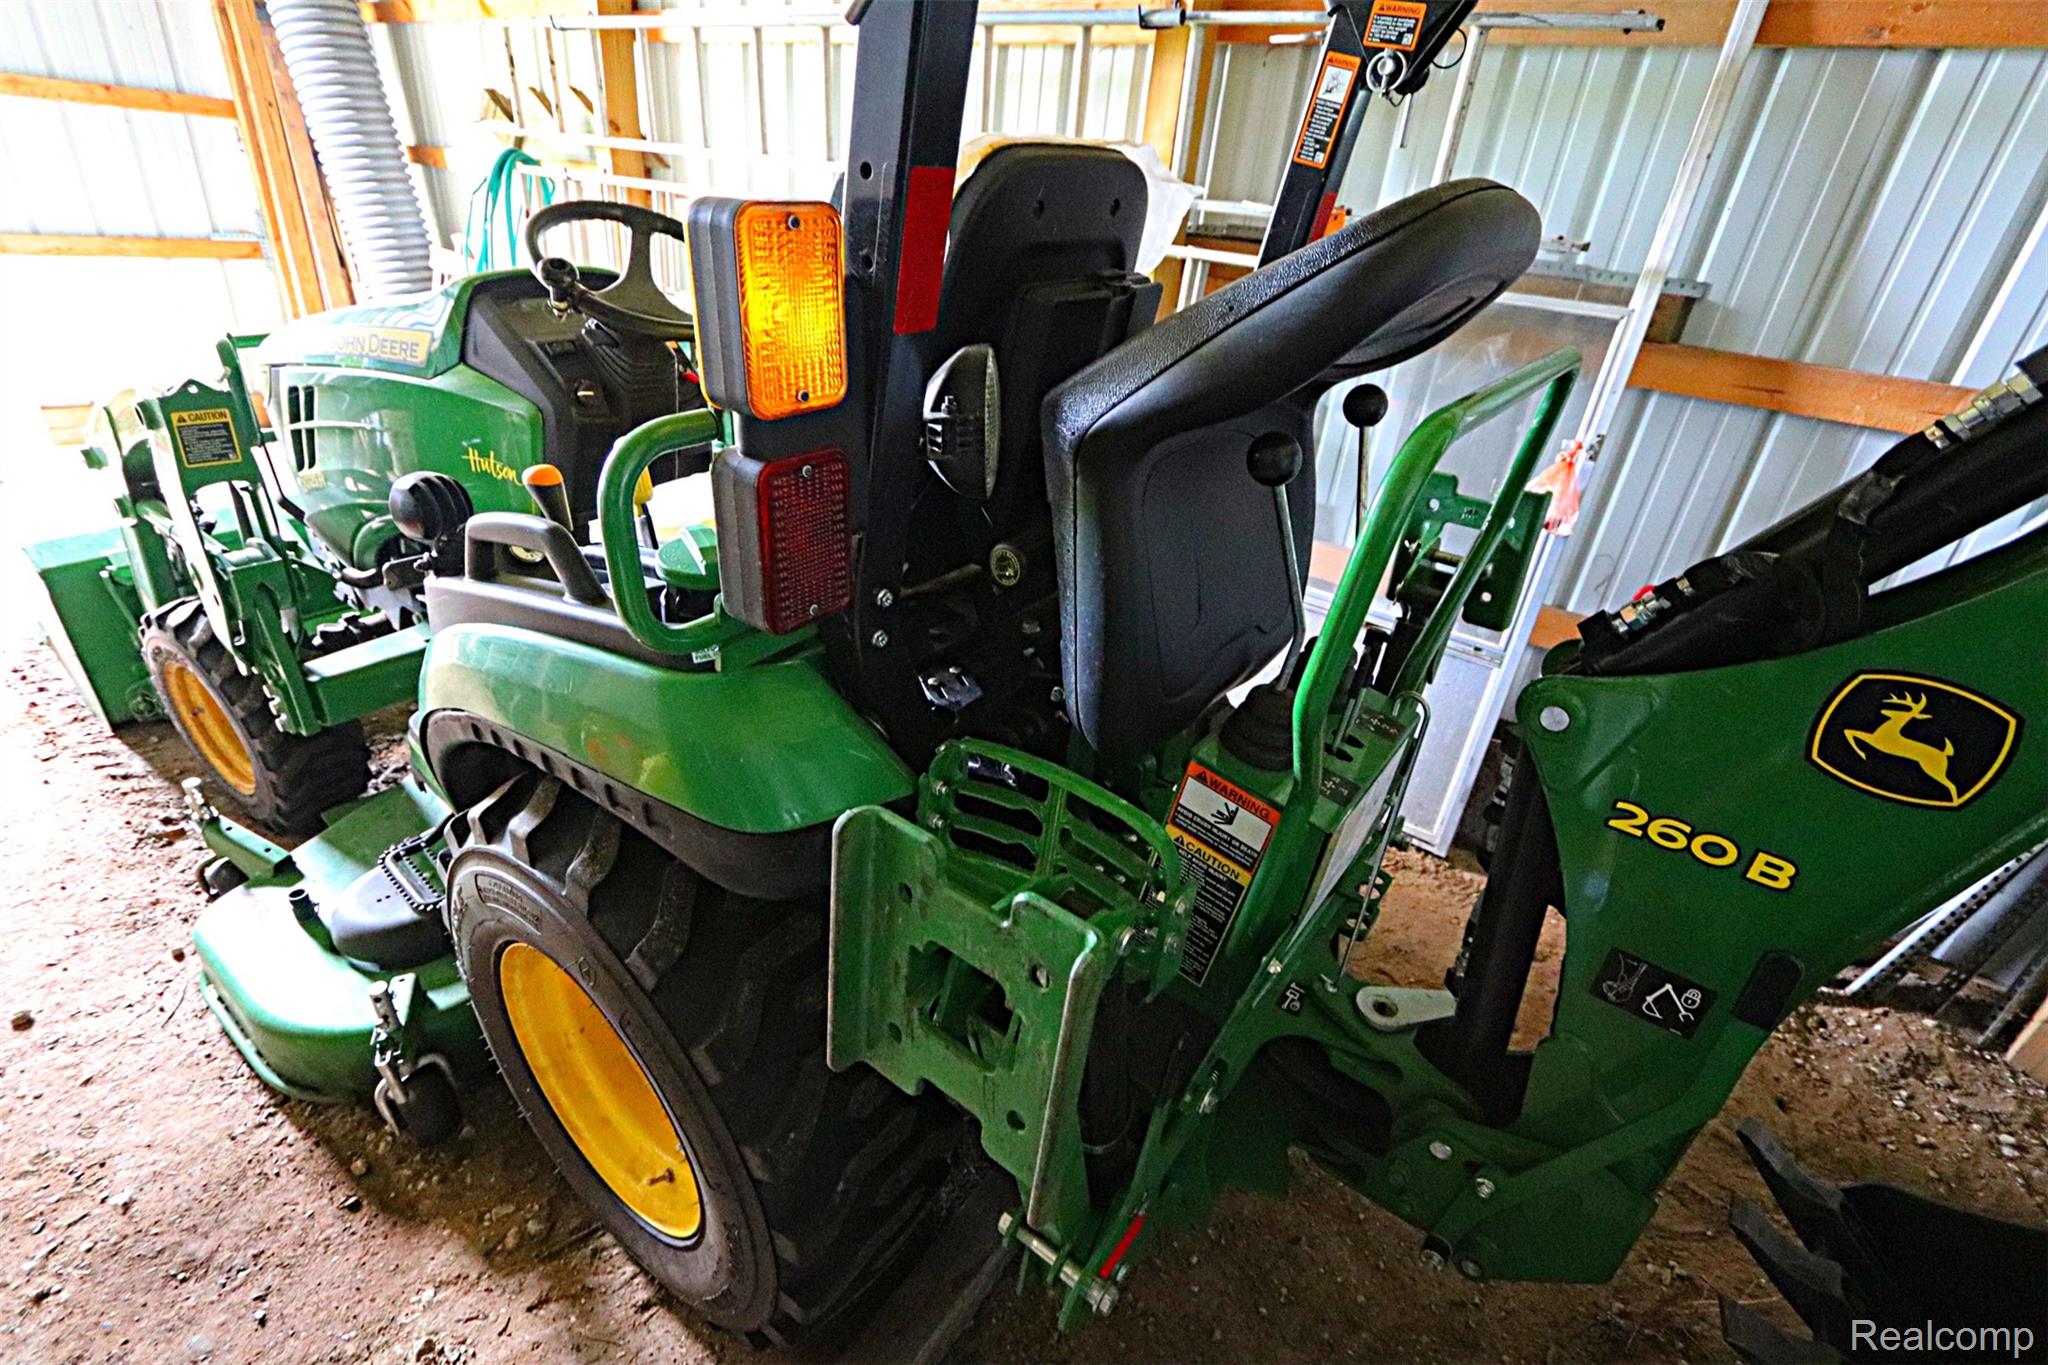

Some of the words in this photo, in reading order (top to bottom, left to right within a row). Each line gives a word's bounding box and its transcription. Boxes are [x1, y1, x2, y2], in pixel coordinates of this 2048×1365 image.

[1385, 3, 1421, 15] WARNING
[368, 333, 420, 360] DEERE
[187, 410, 228, 422] CAUTION
[461, 446, 523, 487] Hutson
[1209, 776, 1270, 820] WARNING
[1185, 841, 1240, 880] CAUTION
[1607, 800, 1739, 867] 260
[1745, 851, 1797, 890] B
